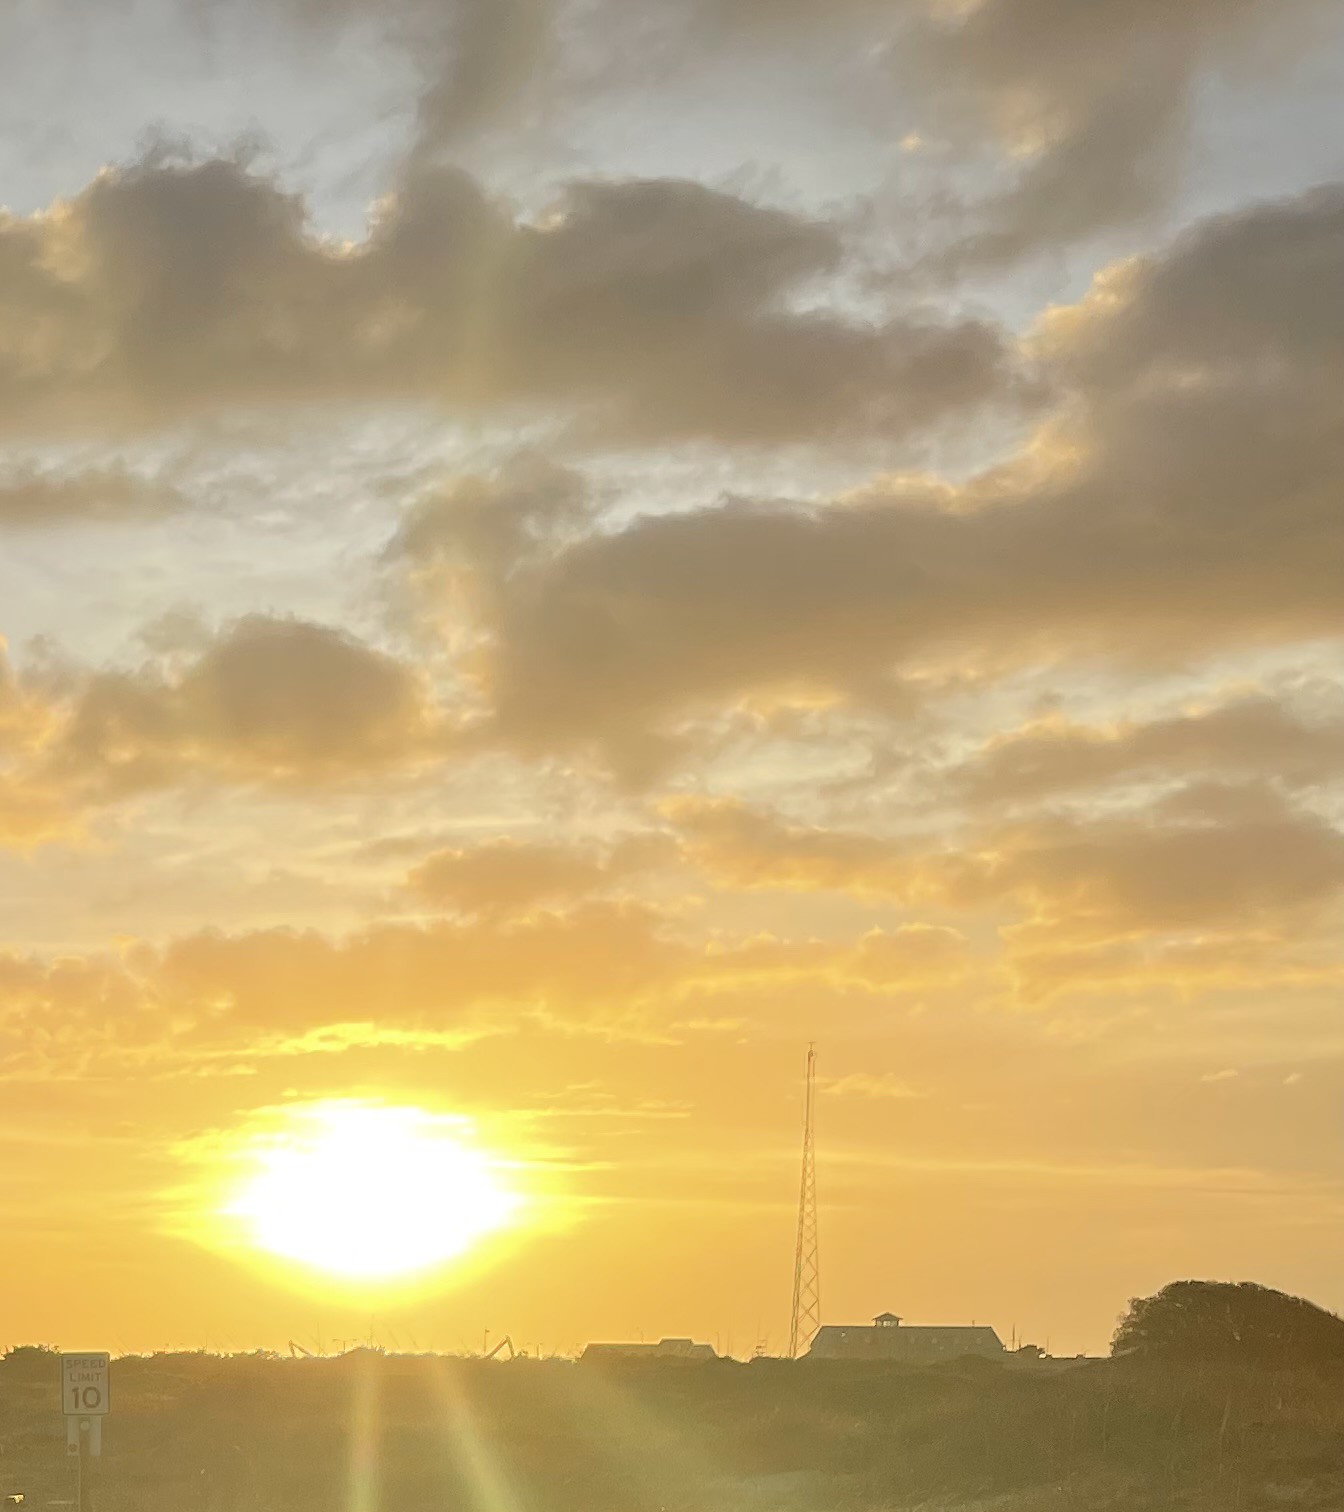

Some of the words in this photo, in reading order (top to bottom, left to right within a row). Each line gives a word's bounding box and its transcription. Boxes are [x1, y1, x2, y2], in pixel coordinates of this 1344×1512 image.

[66, 1359, 106, 1369] SPEED
[70, 1372, 102, 1382] LIMIT
[72, 1386, 101, 1409] 10
